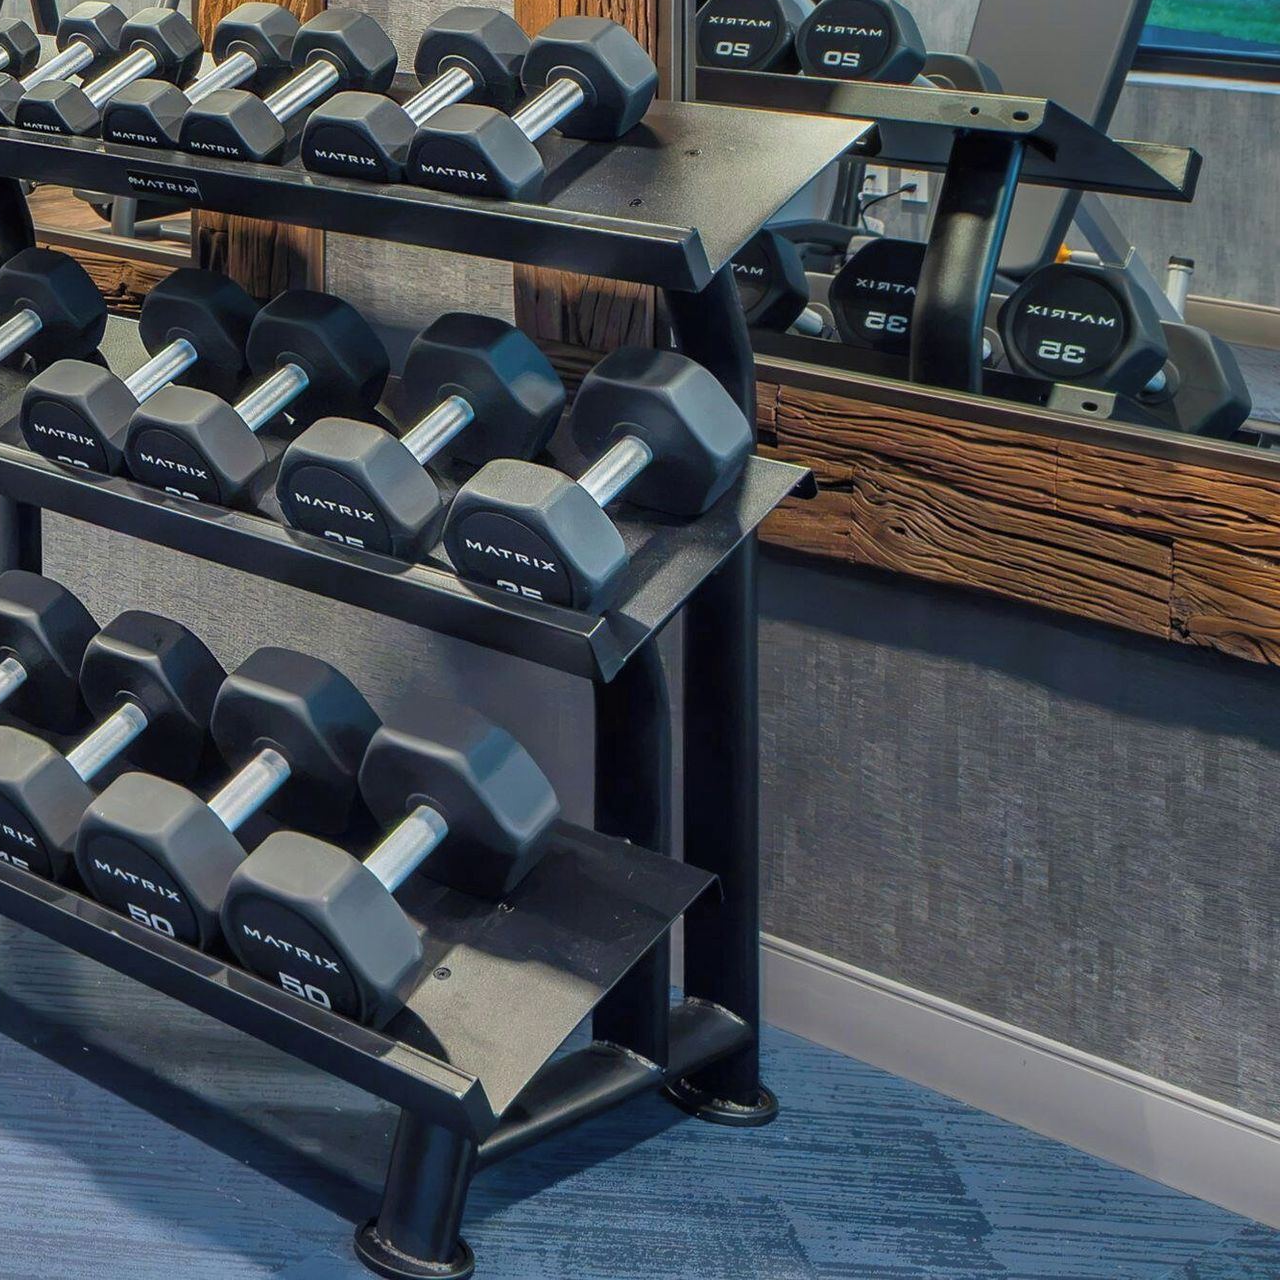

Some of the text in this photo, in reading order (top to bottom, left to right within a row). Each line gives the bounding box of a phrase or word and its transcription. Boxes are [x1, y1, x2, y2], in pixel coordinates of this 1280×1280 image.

[23, 122, 61, 132] MATRIX
[112, 131, 158, 143] MATRIX
[191, 141, 239, 155] MATRIX
[315, 149, 376, 166] MATRIX
[421, 164, 487, 181] MATRIX
[34, 423, 95, 447] MATRIX
[140, 452, 207, 480] MATRIX
[295, 492, 375, 522] MATRIX
[465, 538, 556, 573] MATRIX
[94, 858, 180, 903] MATRIX
[127, 902, 175, 937] 50
[243, 924, 339, 973] MATRIX
[278, 971, 332, 1010] 50
